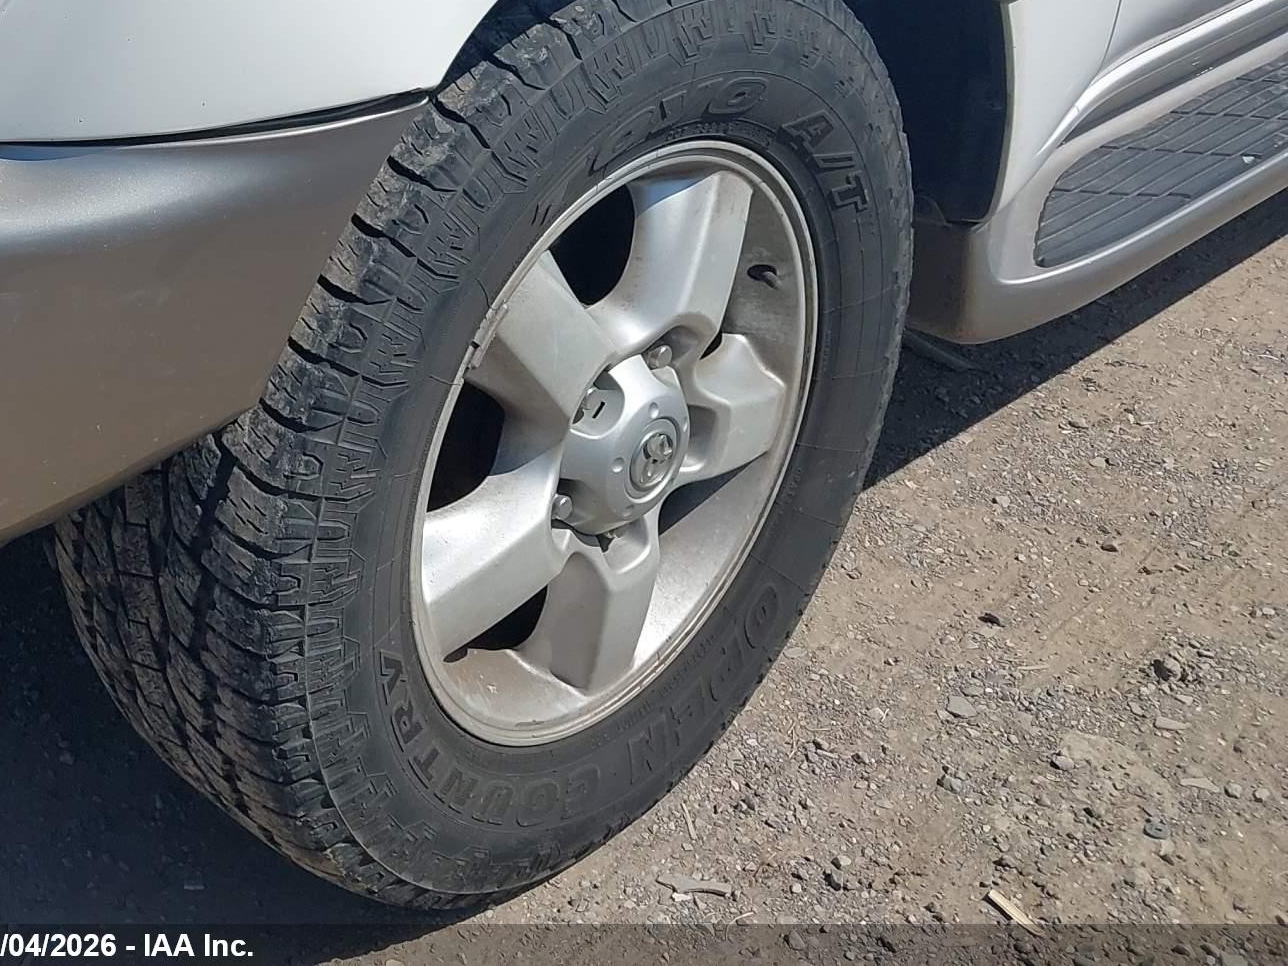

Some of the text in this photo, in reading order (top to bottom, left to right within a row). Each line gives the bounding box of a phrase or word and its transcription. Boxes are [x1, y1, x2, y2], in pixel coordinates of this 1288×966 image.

[779, 108, 870, 215] A/T
[380, 648, 601, 828] COUNTRY
[626, 582, 779, 786] OPEN
